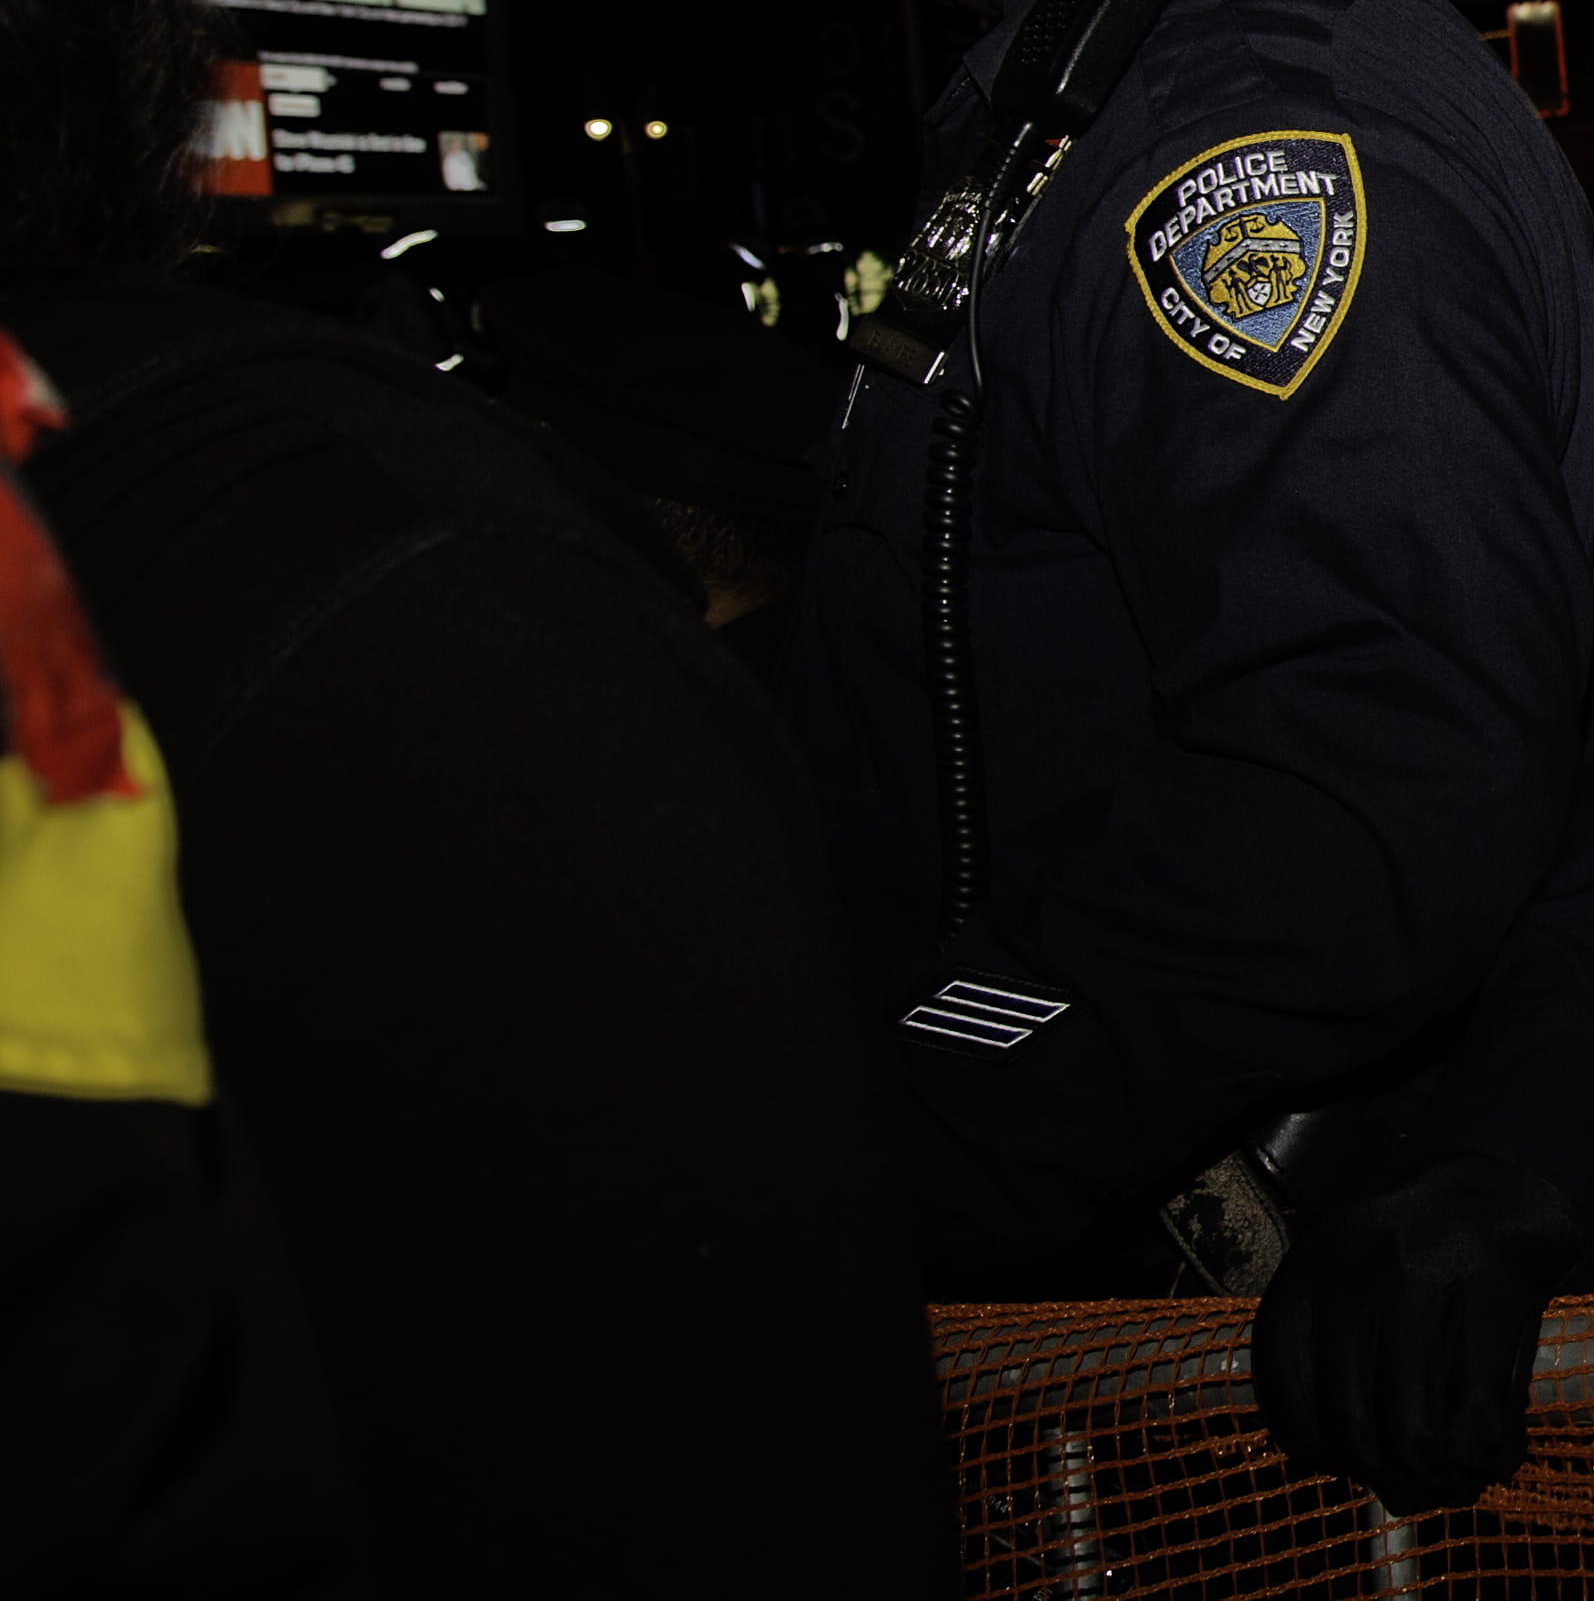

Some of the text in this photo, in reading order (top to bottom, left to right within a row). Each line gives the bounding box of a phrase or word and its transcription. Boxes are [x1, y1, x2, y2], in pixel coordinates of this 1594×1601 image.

[1149, 170, 1338, 262] DEPARTMENT
[1178, 150, 1290, 208] POLICE
[1160, 210, 1355, 361] CITY OF NEW YORK
